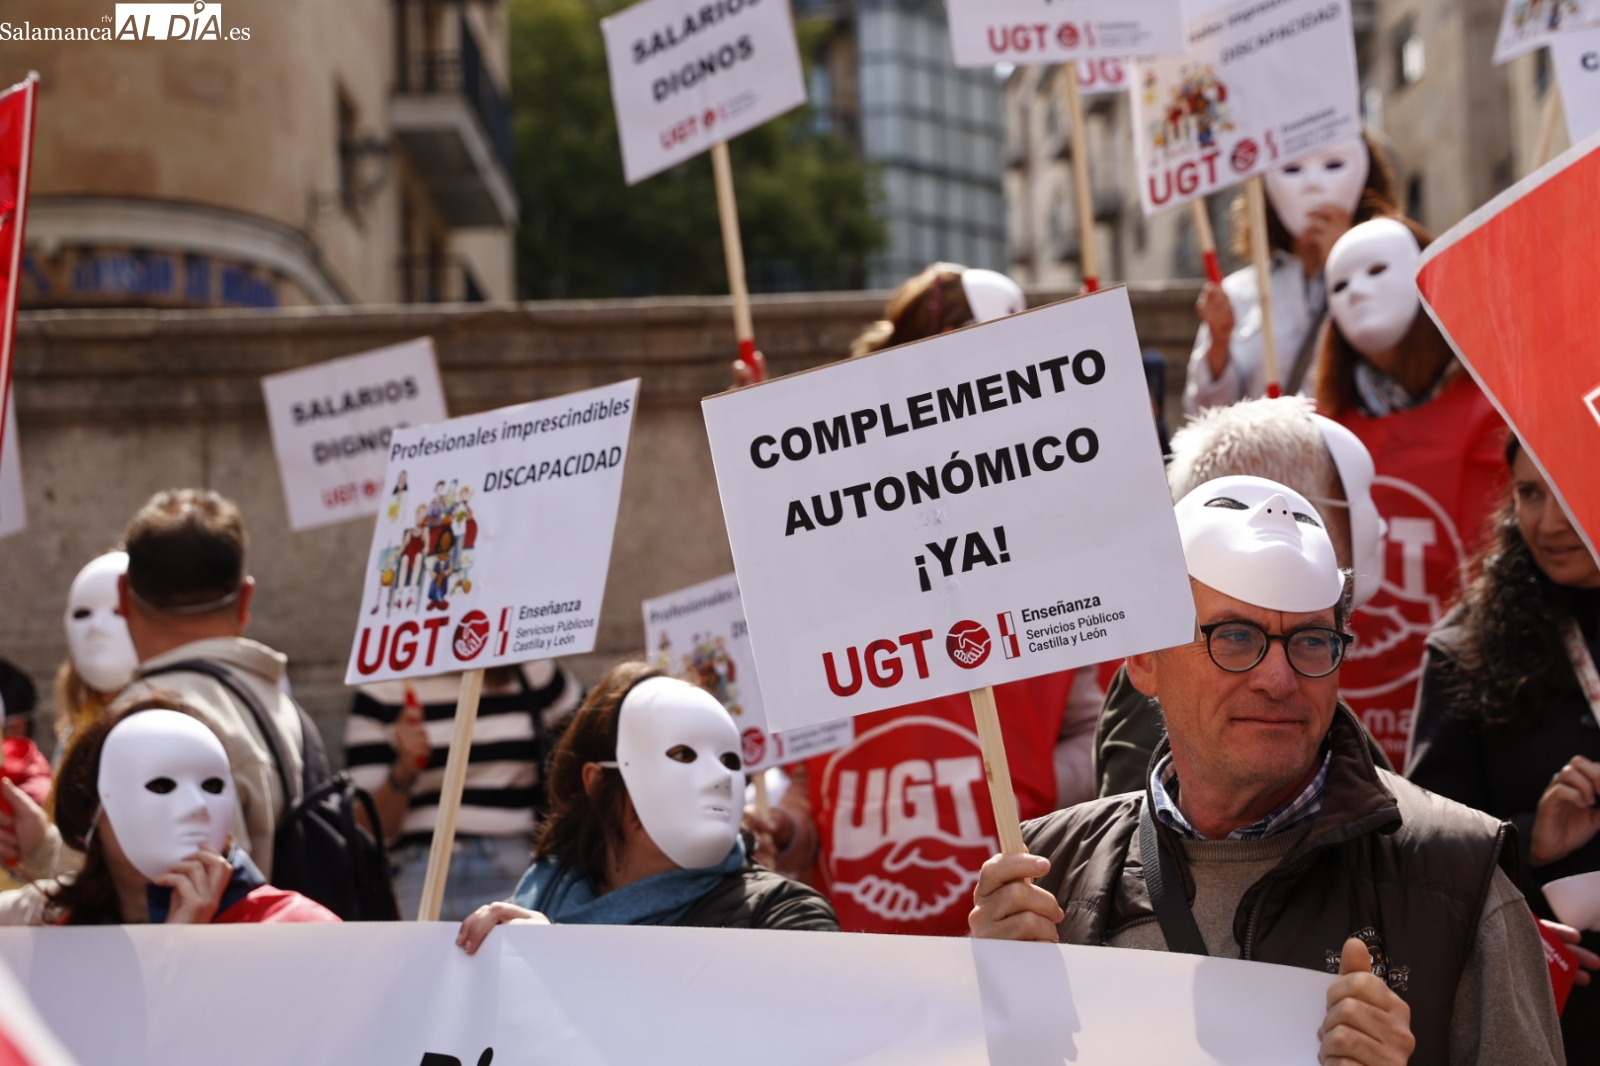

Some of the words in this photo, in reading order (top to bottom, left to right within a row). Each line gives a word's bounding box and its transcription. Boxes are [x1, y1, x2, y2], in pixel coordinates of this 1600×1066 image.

[632, 0, 764, 64] SALARIO
[988, 22, 1049, 54] UGT
[1219, 2, 1342, 64] DISCAPACIDAD
[652, 34, 754, 103] DIGNOS
[659, 113, 698, 150] UGT
[1148, 150, 1221, 206] UGT
[291, 376, 418, 425] SALARIOS
[749, 348, 1107, 469] COMPLEMENTO
[312, 422, 410, 465] DIGNO
[391, 427, 498, 461] Profesionales
[501, 398, 630, 441] imprescindibles
[482, 445, 622, 493] DISCAPACIDAD
[784, 427, 1100, 537] AUTONÓMICO
[321, 480, 360, 508] UGT
[914, 525, 1012, 593] ¡YA!
[515, 624, 555, 639] Servicios
[557, 618, 595, 633] Públicos
[519, 599, 582, 620] Enseñanza
[1021, 595, 1102, 623] Enseñanza
[1026, 621, 1077, 640] Servicios
[1077, 610, 1126, 629] Públicos
[356, 615, 450, 675] UGT
[512, 637, 546, 653] Castilla
[822, 629, 934, 697] UGT
[1028, 635, 1070, 653] Castilla
[1070, 634, 1078, 647] y
[1079, 627, 1107, 642] León
[833, 755, 986, 860] UGT
